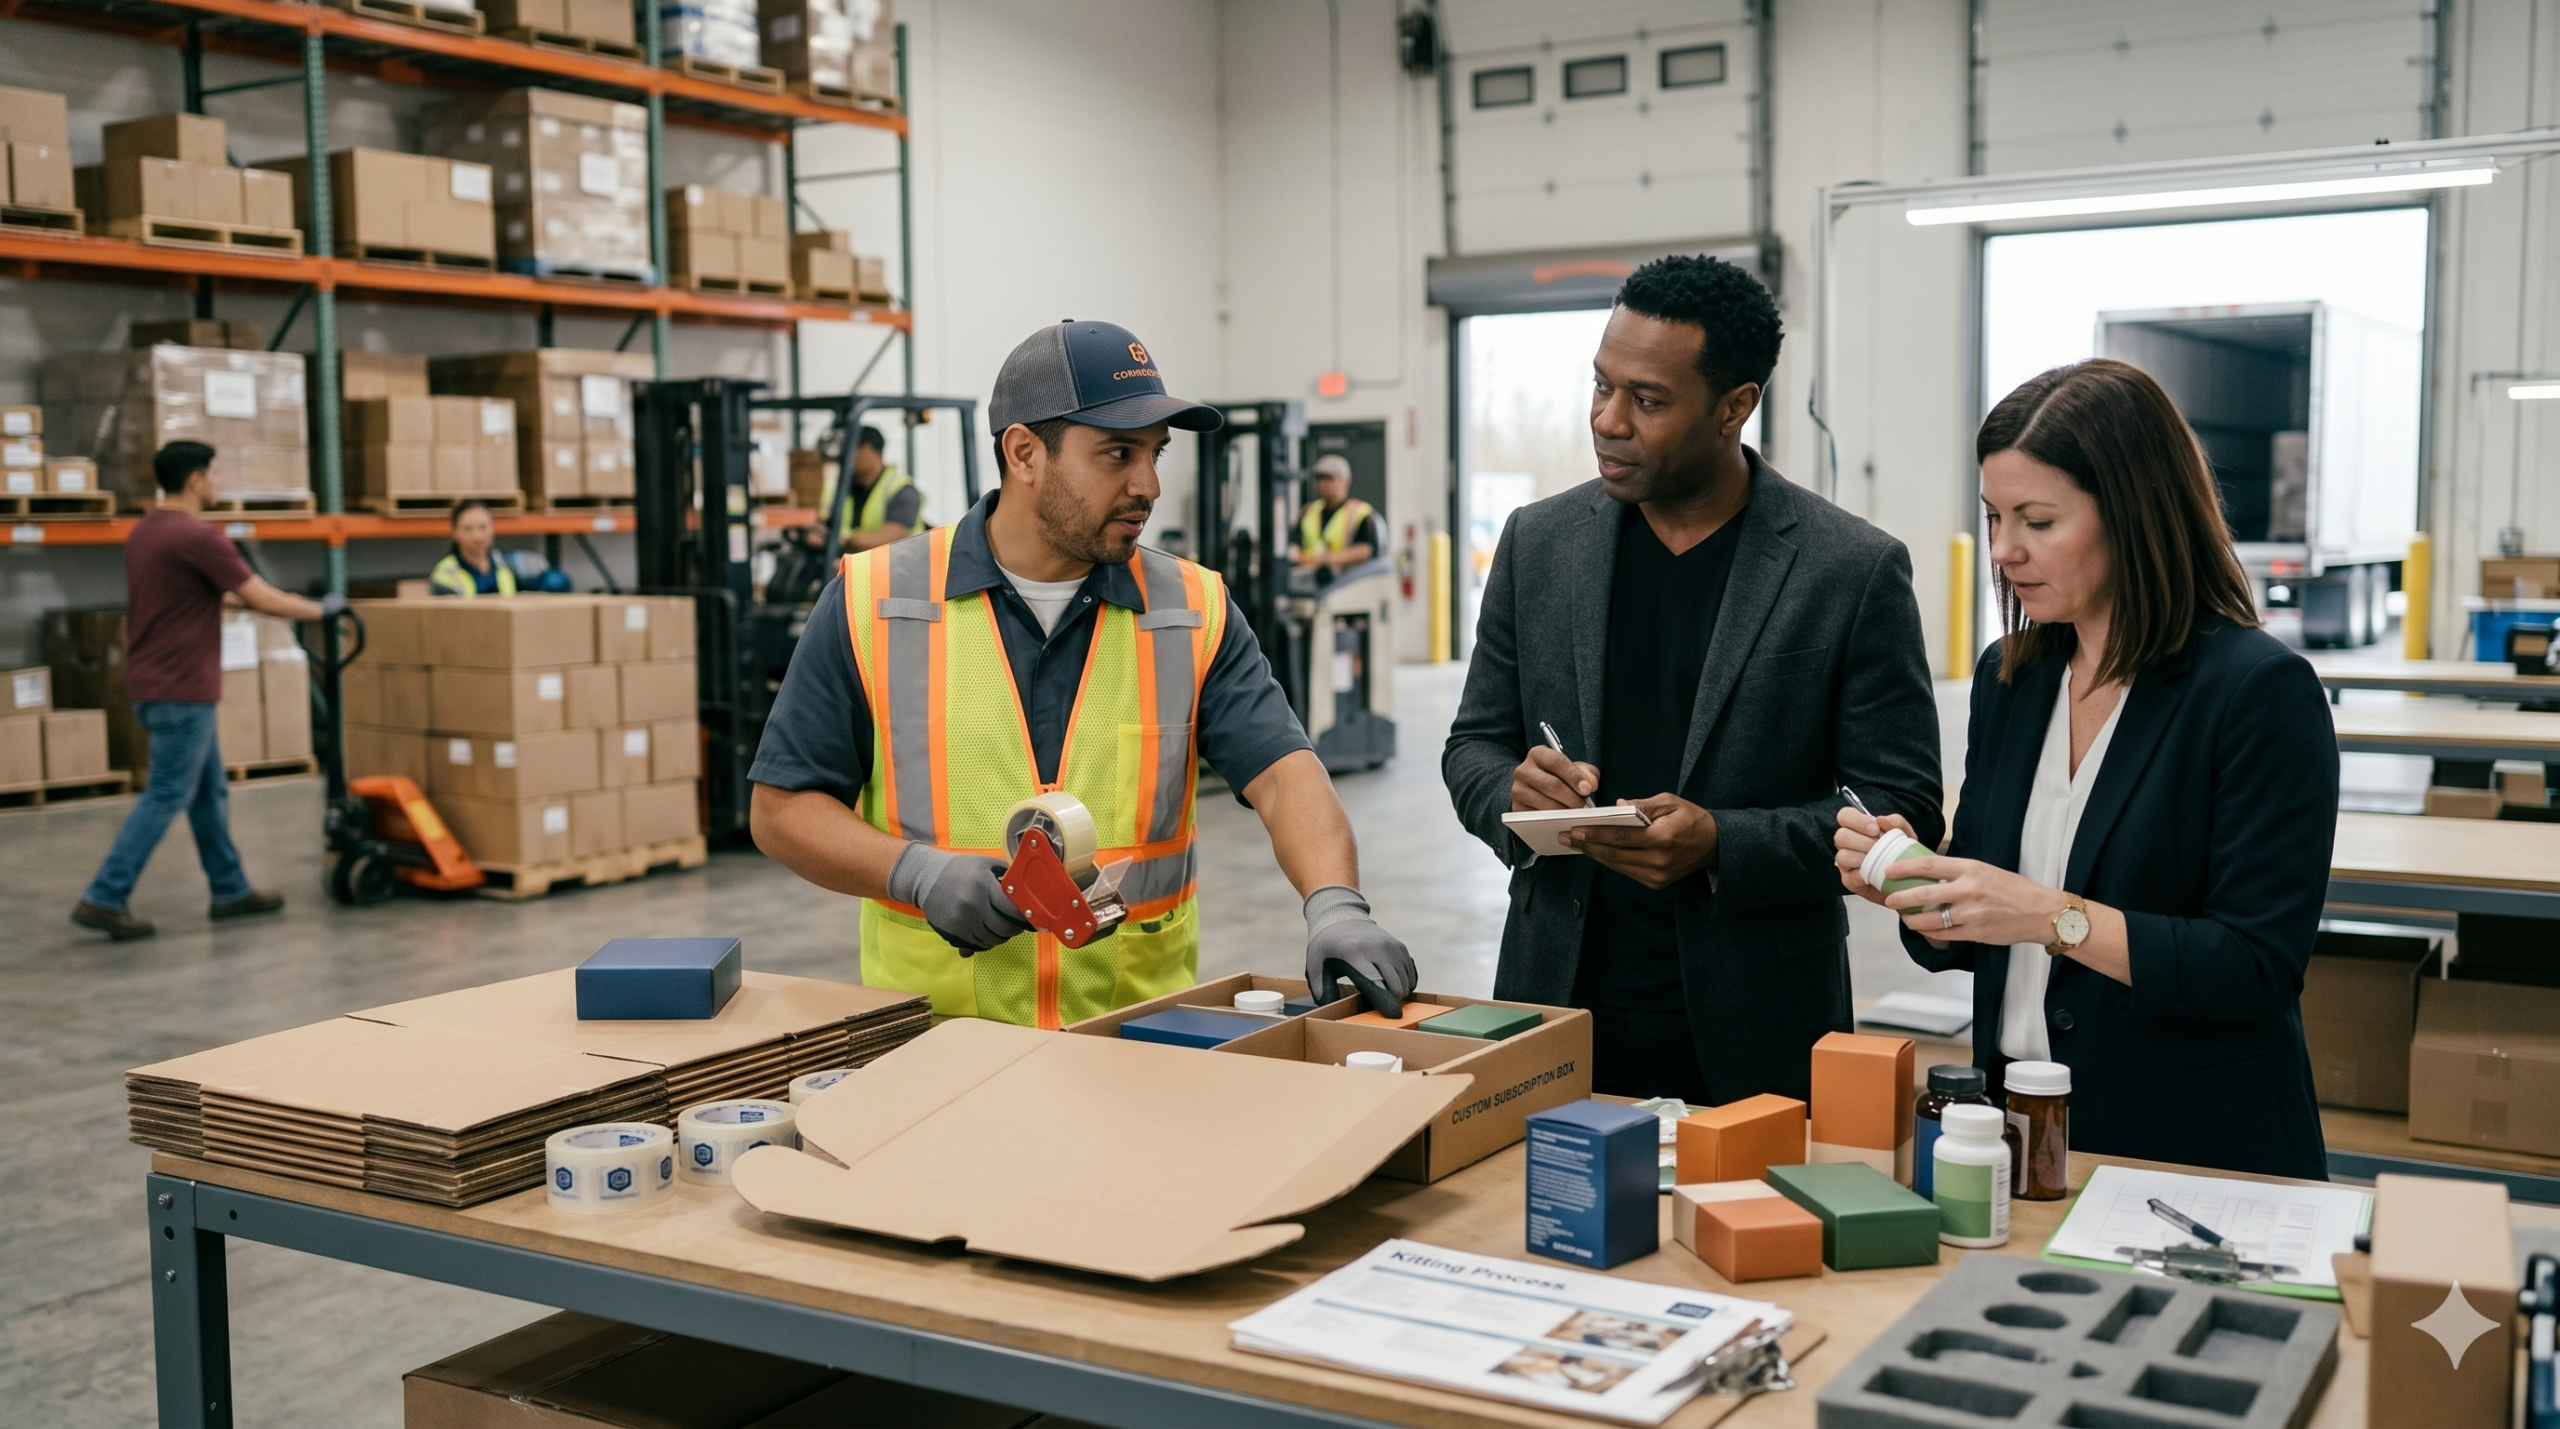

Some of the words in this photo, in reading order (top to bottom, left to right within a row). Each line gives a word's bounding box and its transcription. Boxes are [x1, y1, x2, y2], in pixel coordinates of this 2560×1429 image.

[1452, 1096, 1492, 1125] CUSTOM
[1494, 1069, 1555, 1107] SUBSCRIPTION
[1556, 1060, 1575, 1079] BOX
[1390, 1250, 1466, 1274] Kitting
[1471, 1266, 1566, 1290] Process
